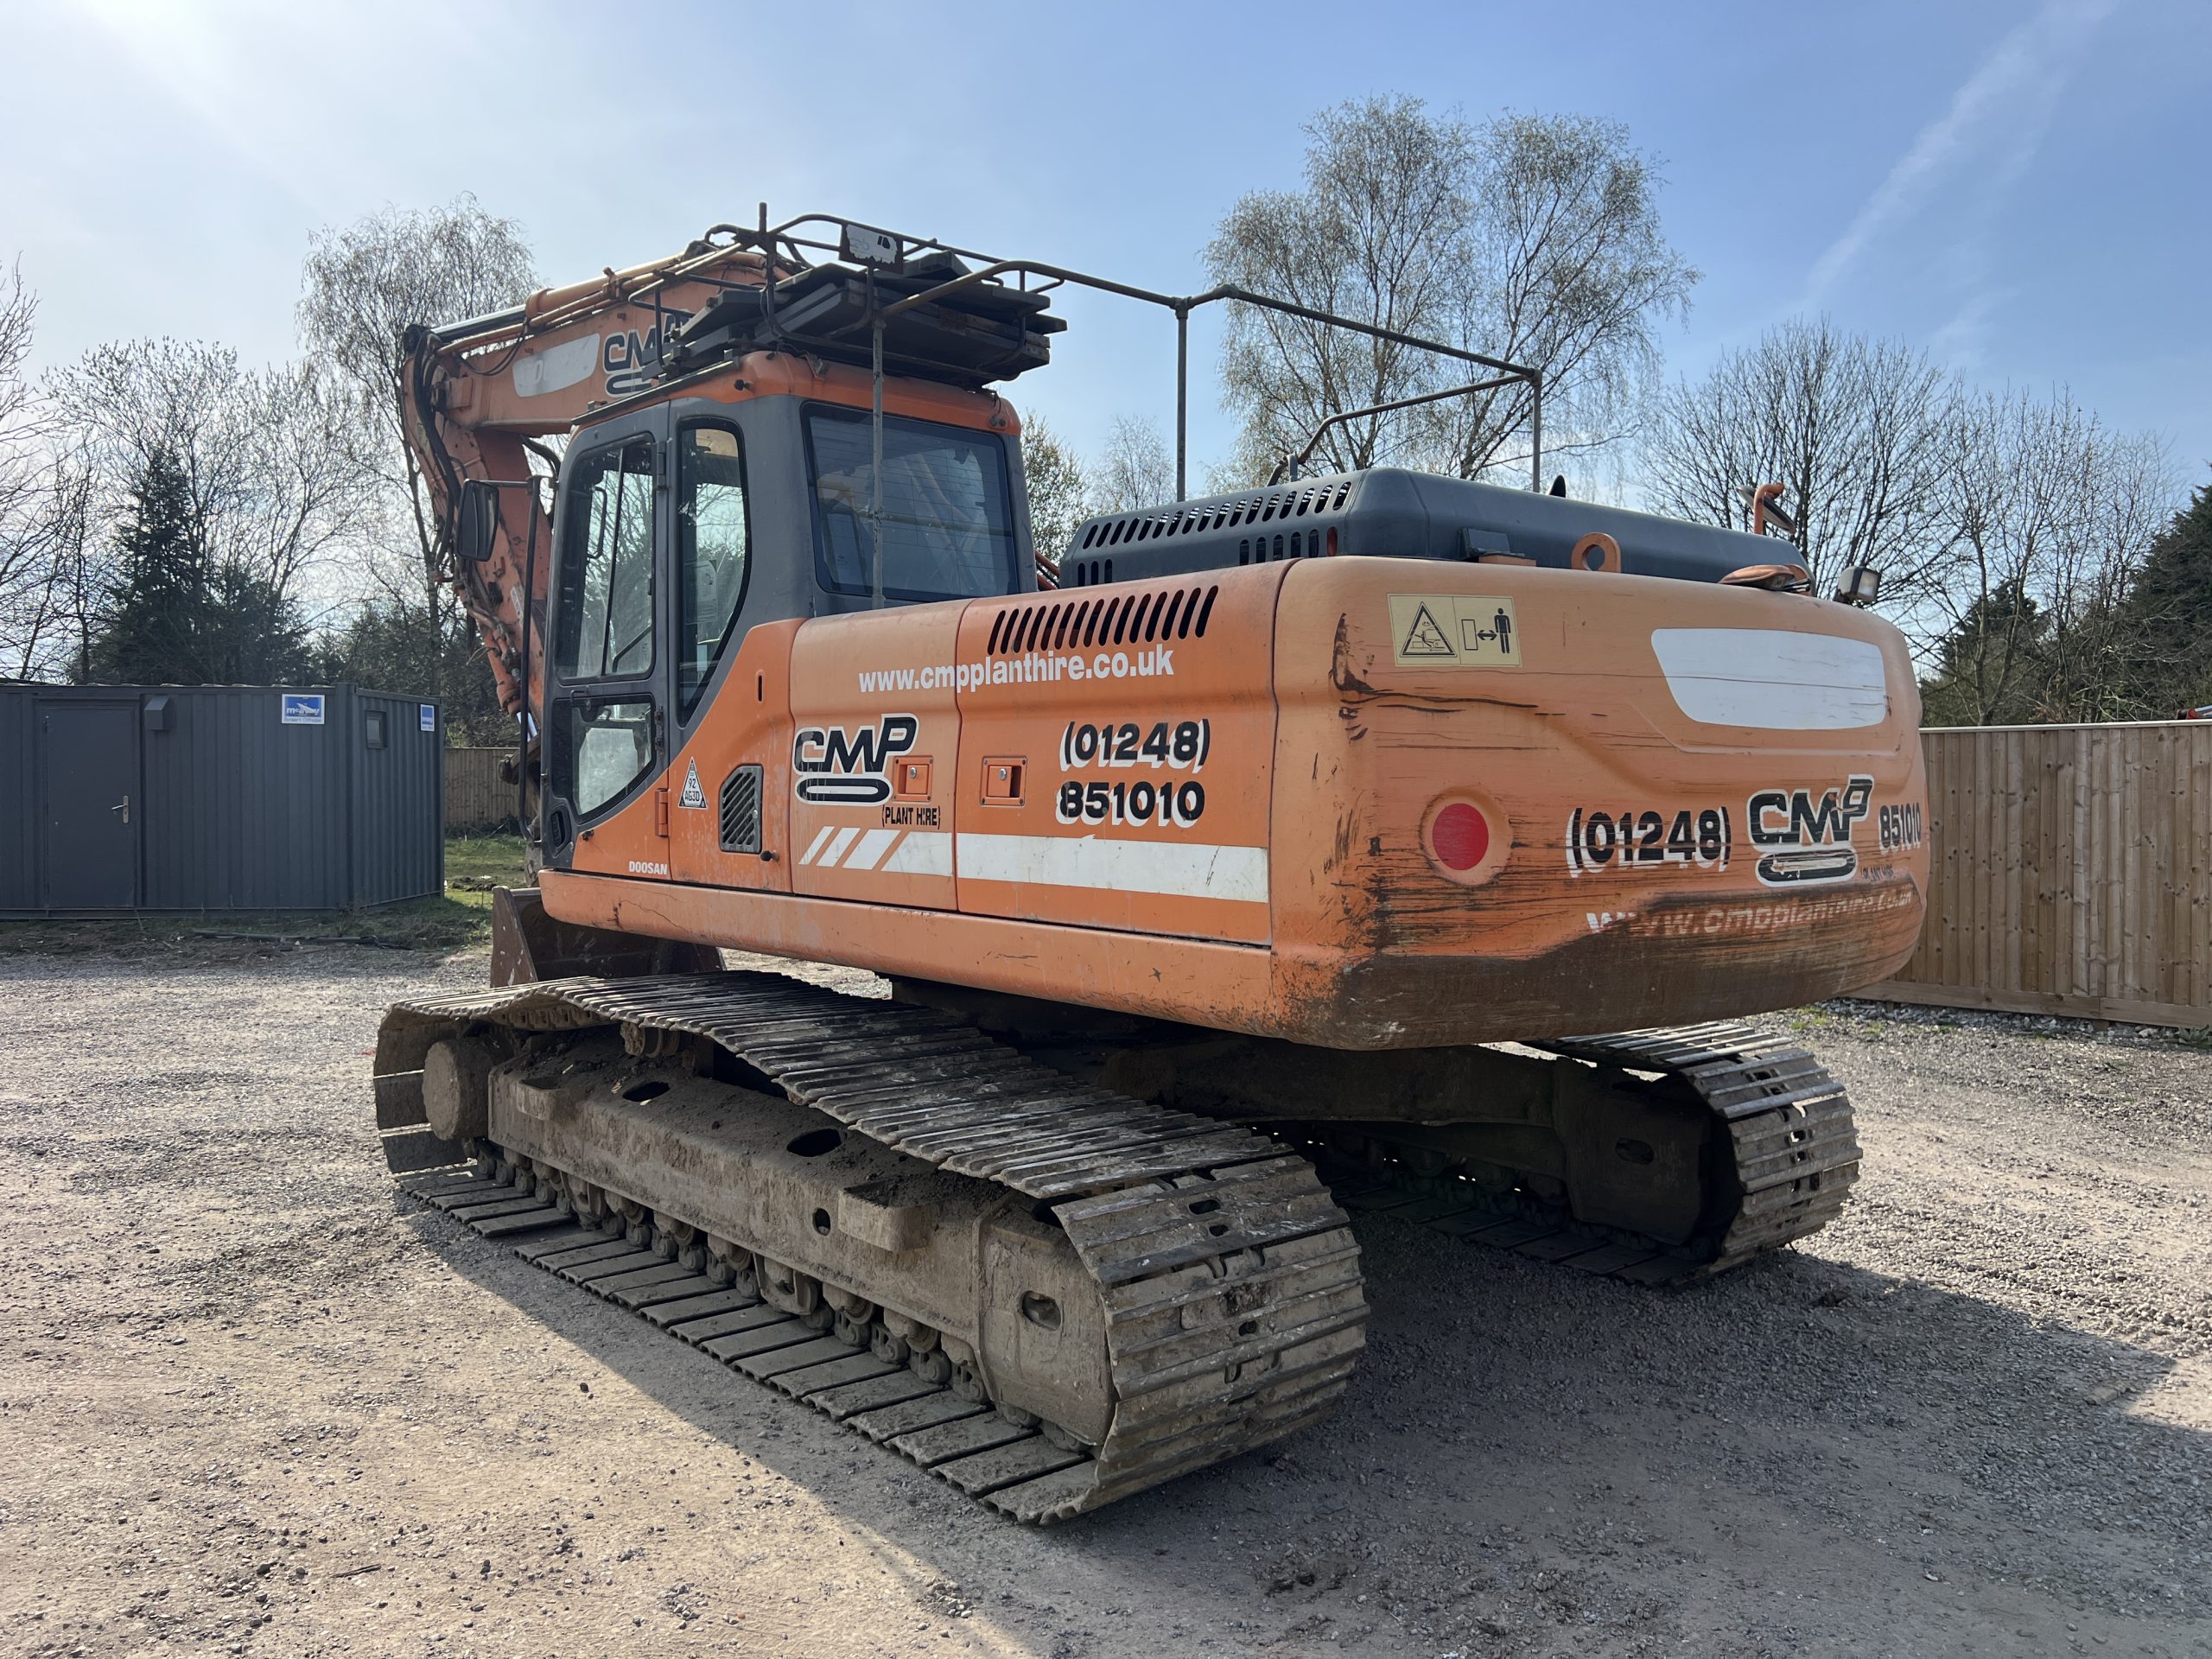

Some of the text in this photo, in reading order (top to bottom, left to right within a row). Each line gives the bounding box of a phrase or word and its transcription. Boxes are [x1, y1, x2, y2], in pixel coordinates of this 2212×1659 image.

[859, 644, 1174, 693] www.cmpplanthire.co.uk
[794, 712, 919, 776] CMP
[1059, 719, 1211, 773] (01248)
[688, 778, 696, 789] 92
[1056, 781, 1206, 828] 851010
[1745, 773, 1874, 852] CMP
[1566, 801, 1922, 879] (01248) 851010
[628, 861, 668, 875] DOOSAN
